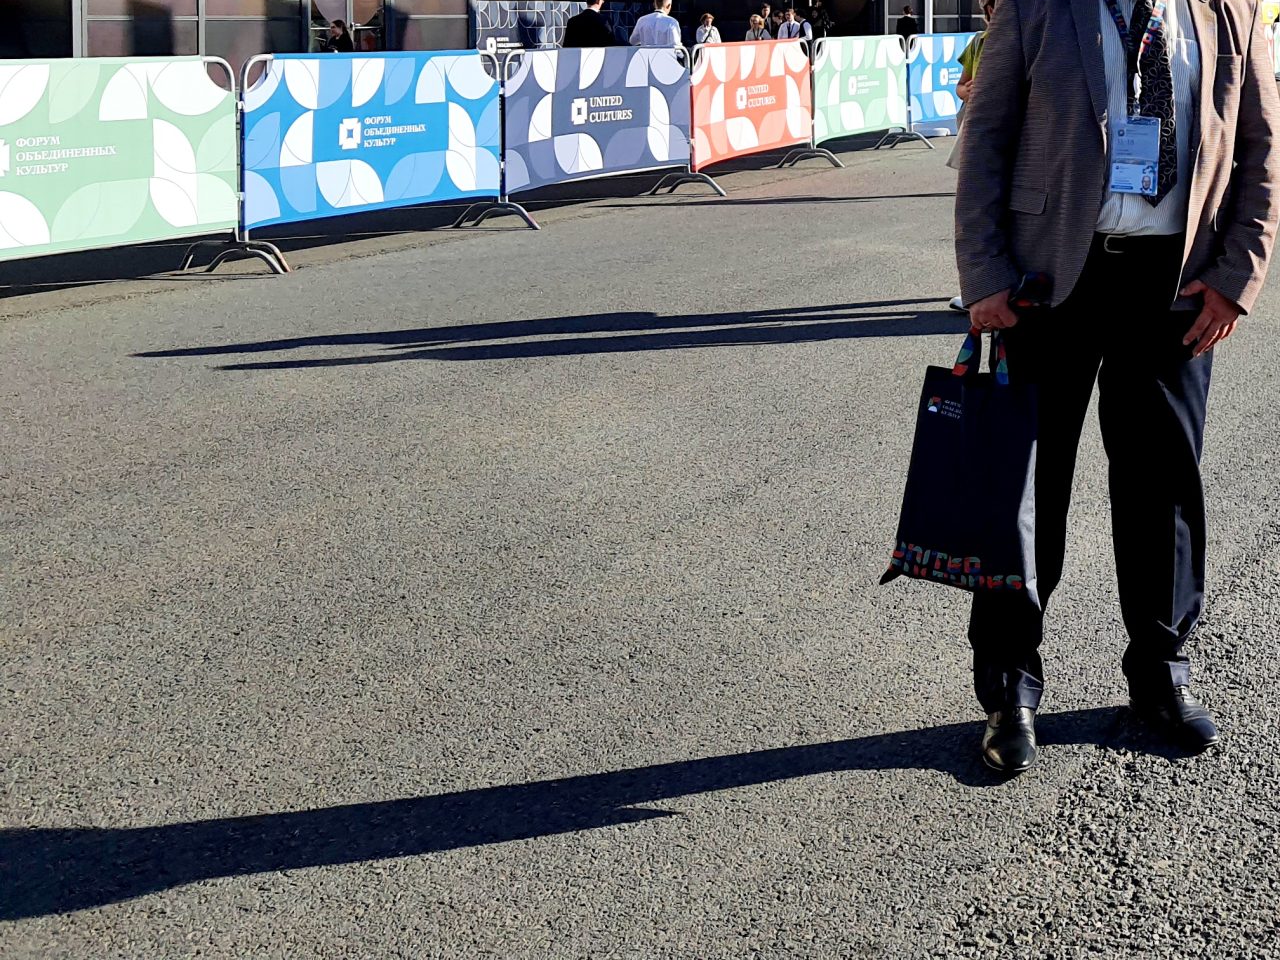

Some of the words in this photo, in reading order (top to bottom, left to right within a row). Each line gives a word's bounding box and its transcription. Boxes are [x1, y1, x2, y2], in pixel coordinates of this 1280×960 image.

[589, 95, 623, 108] UNITED
[363, 115, 393, 125] ФОРУМ
[589, 109, 634, 123] CULTURES
[363, 124, 427, 141] ОБЪЕДИНЕННЫХ
[16, 135, 60, 148] ФОРУМ
[363, 137, 397, 148] КУЛЬТУР
[16, 145, 117, 162] ОБЪЕДИНЕННЫХ
[16, 163, 69, 176] КУЛЬТУР
